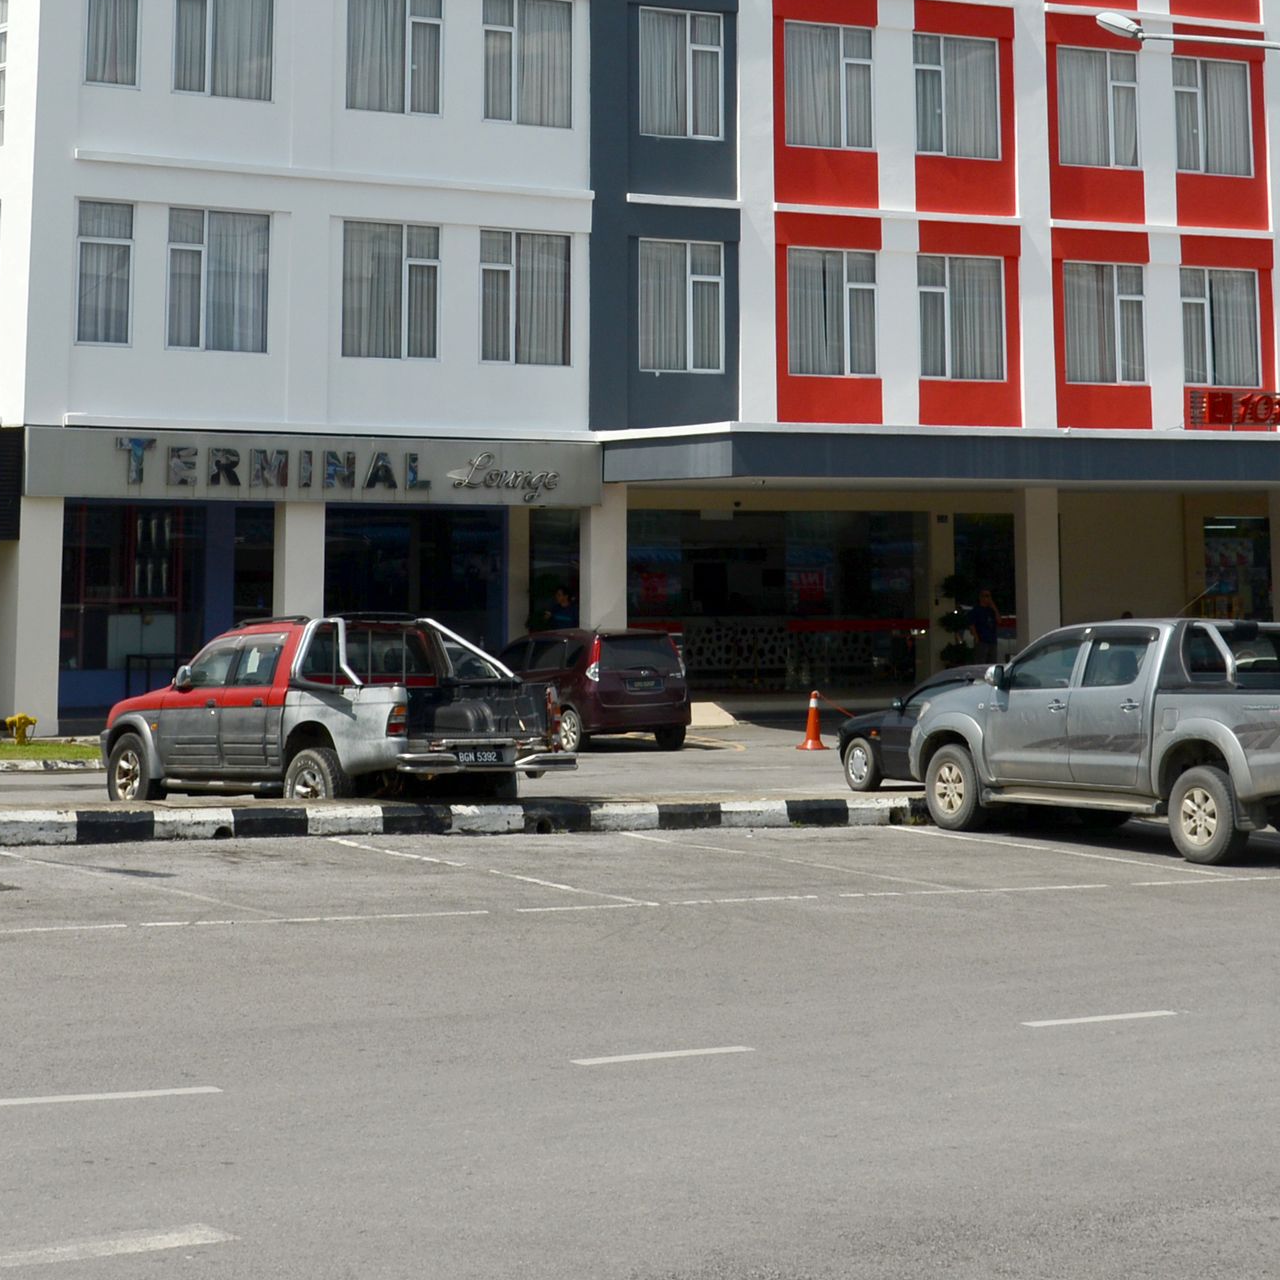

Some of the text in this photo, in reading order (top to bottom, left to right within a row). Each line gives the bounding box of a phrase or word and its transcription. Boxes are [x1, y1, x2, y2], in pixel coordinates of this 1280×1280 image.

[116, 438, 560, 501] TERMINAL Lounge
[458, 751, 497, 762] BGN 5392
